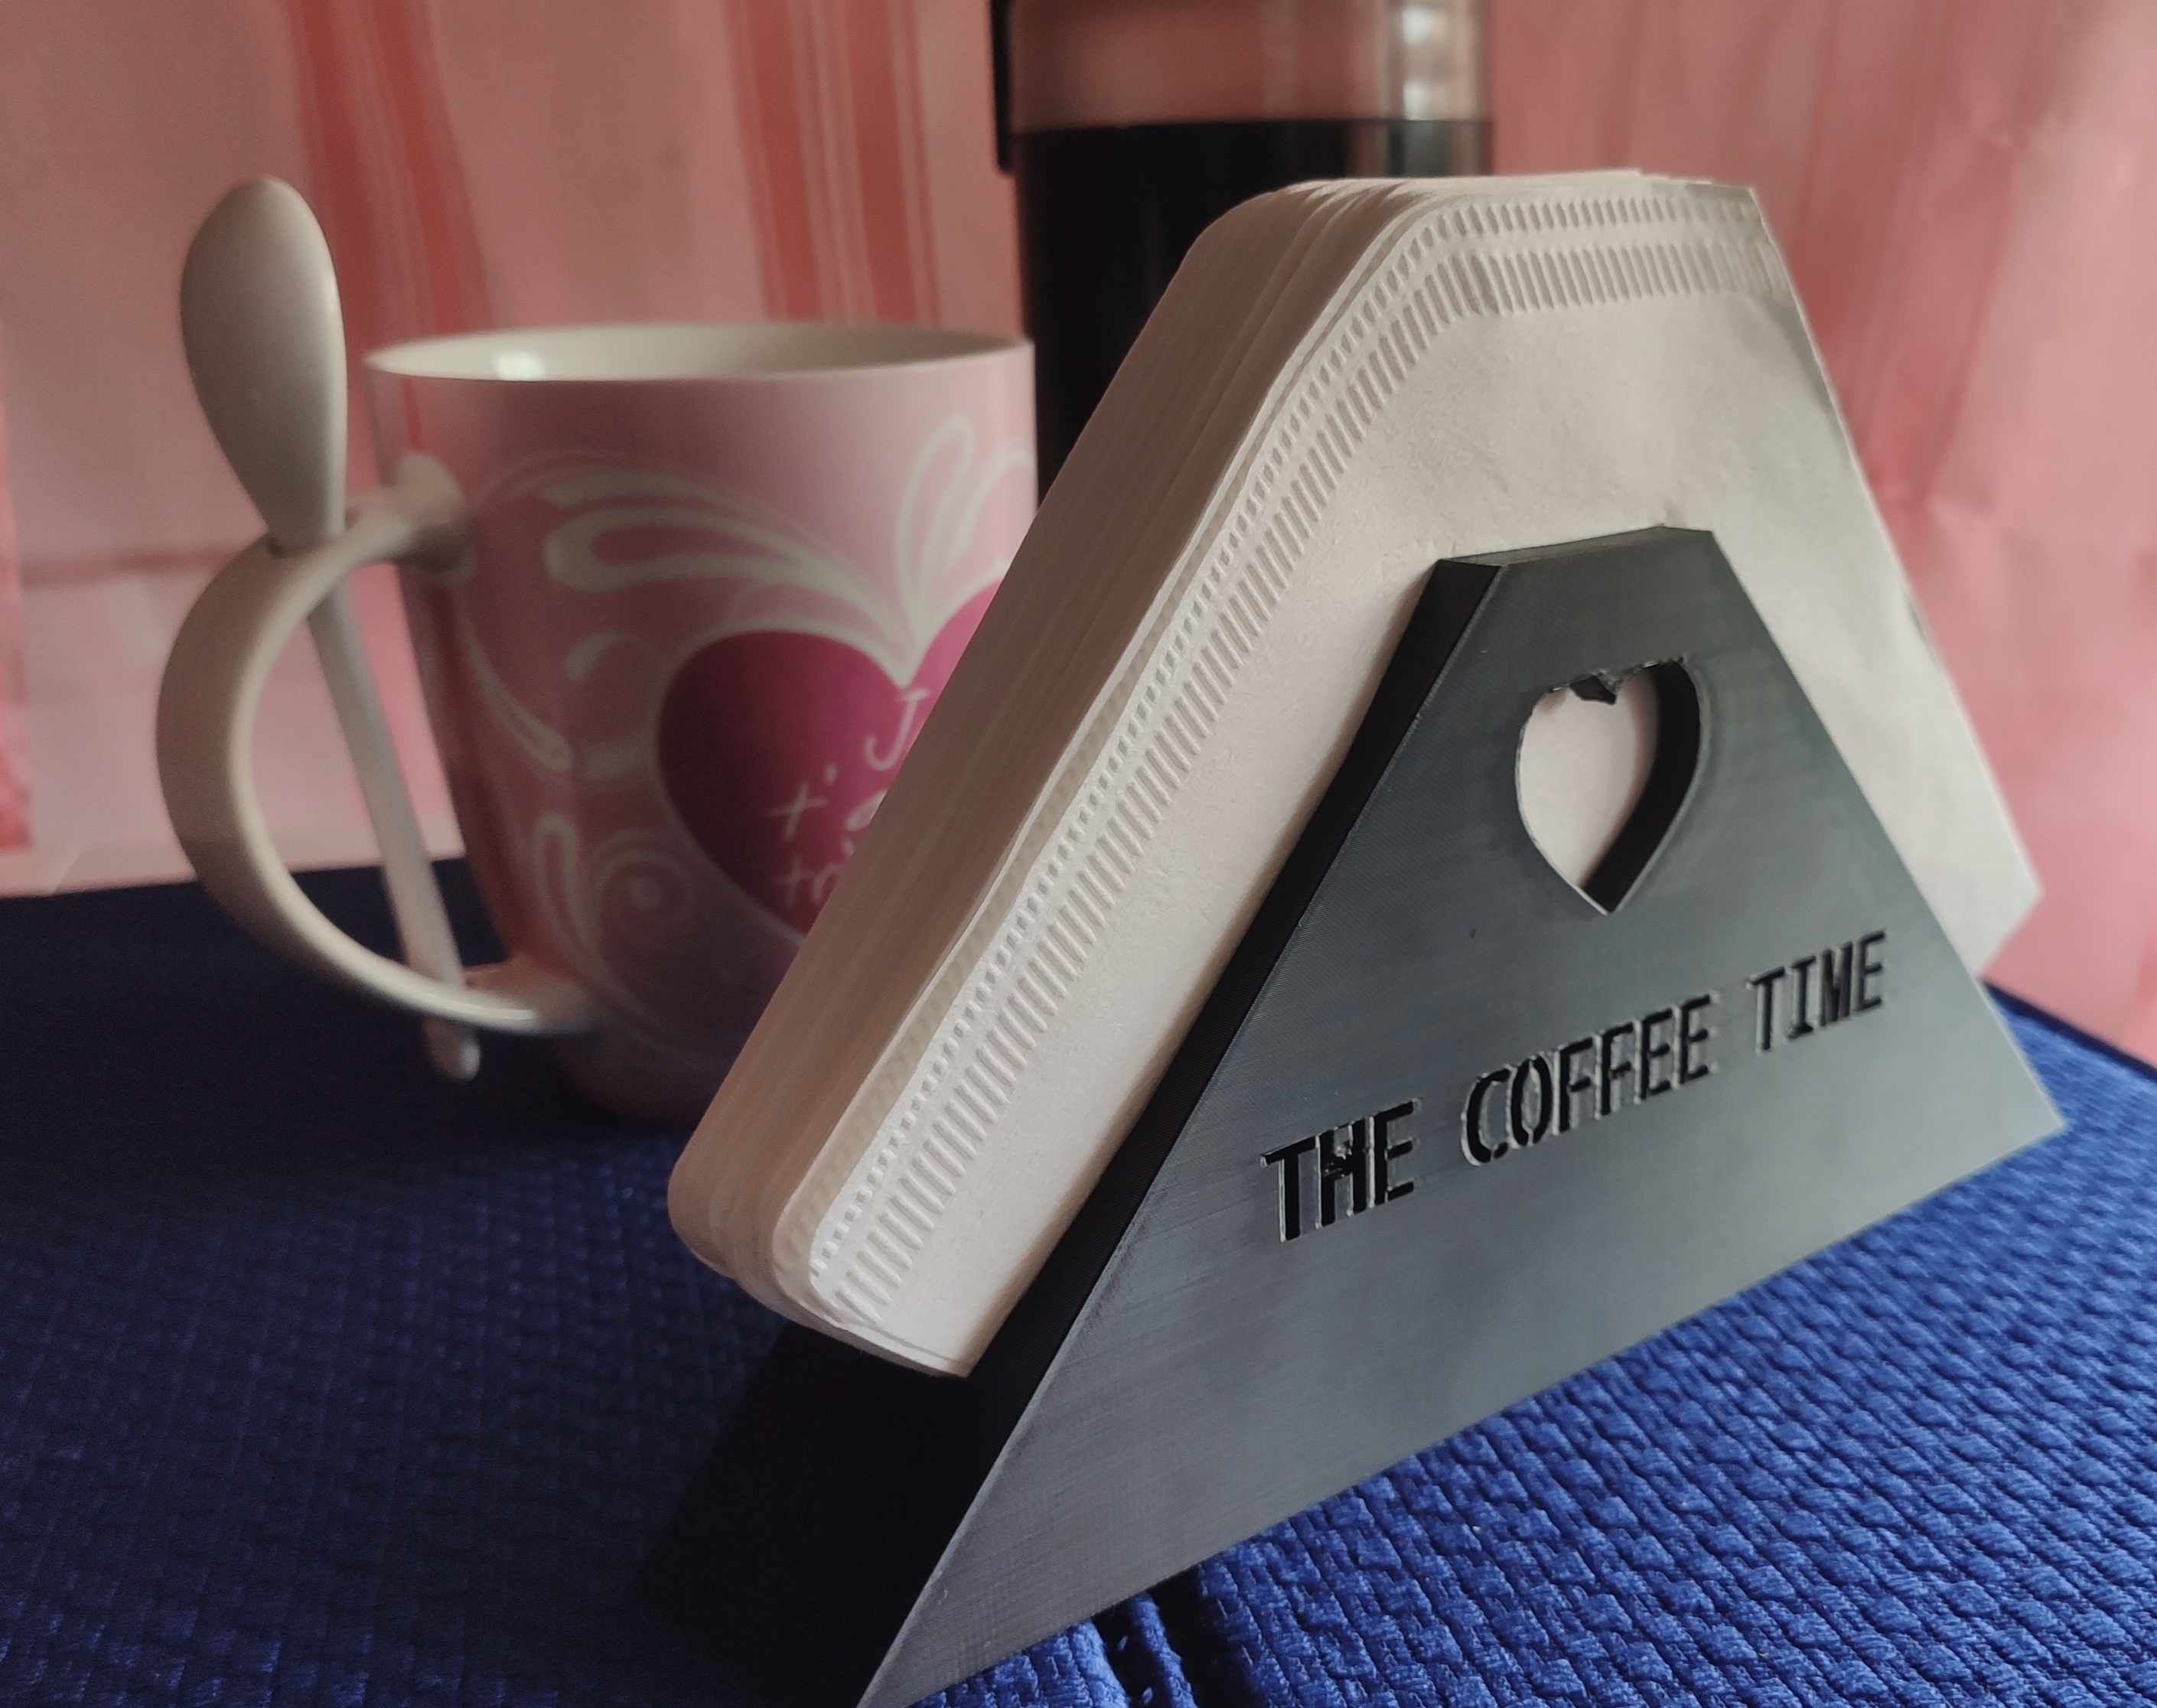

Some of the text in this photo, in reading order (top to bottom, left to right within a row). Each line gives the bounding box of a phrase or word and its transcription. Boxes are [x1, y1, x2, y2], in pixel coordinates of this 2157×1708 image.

[1259, 929, 1886, 1243] THE COFFEE TIME
